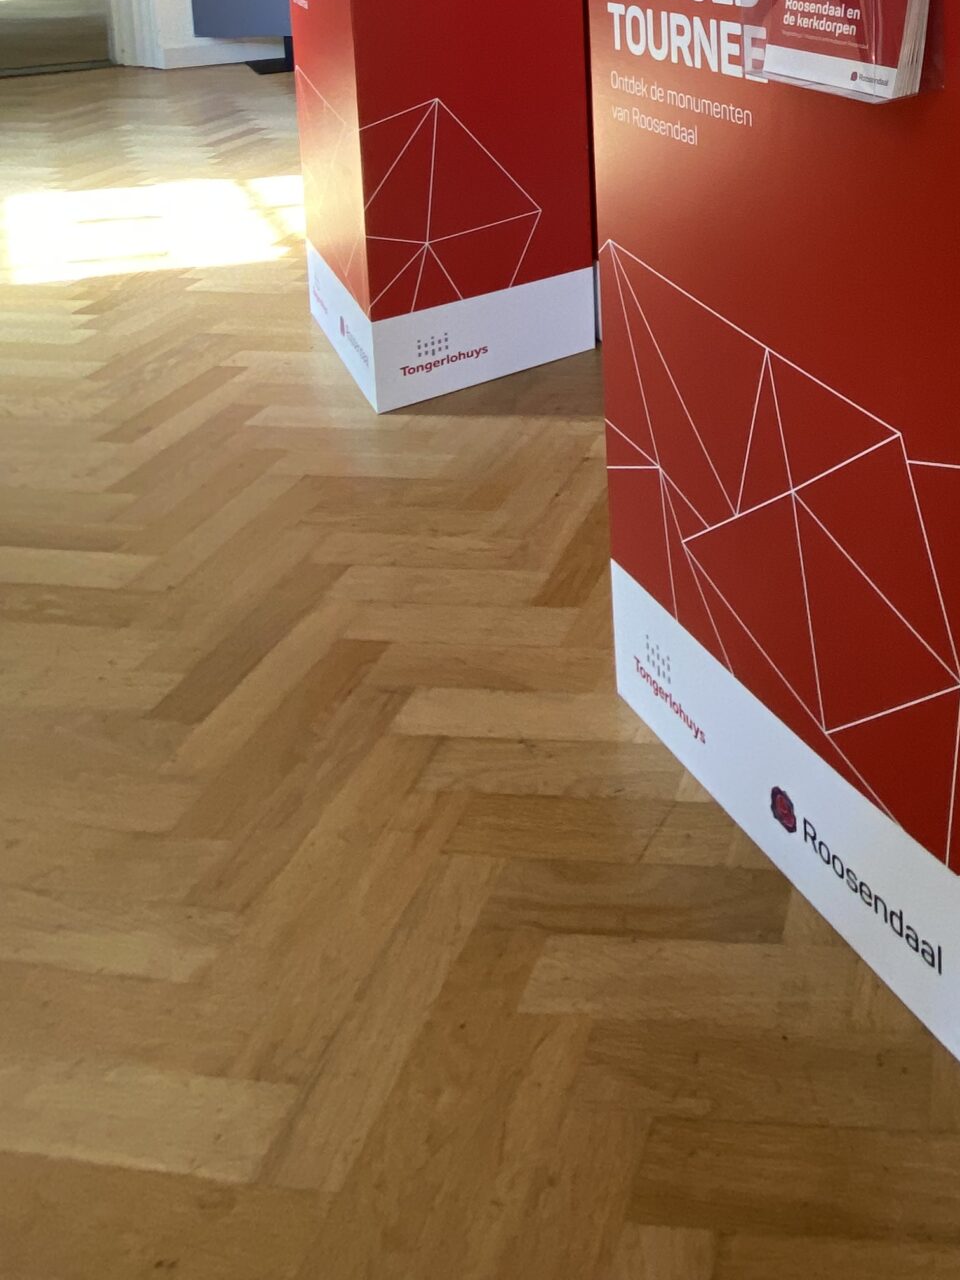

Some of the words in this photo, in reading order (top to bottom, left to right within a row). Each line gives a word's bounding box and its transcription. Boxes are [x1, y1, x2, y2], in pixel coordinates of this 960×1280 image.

[783, 12, 795, 26] de
[796, 14, 857, 37] kerkdorpen
[846, 6, 861, 20] en
[607, 2, 769, 84] TOURNEE
[610, 70, 648, 96] Ontdek
[650, 81, 665, 103] de
[667, 85, 753, 127] monumenten
[859, 73, 889, 87] Roosendaal
[611, 103, 631, 122] van
[632, 107, 698, 146] Roosendaal
[400, 345, 489, 377] Tongerlohuys
[633, 655, 706, 745] Tongerlohuys
[802, 816, 943, 976] Roosendaal
